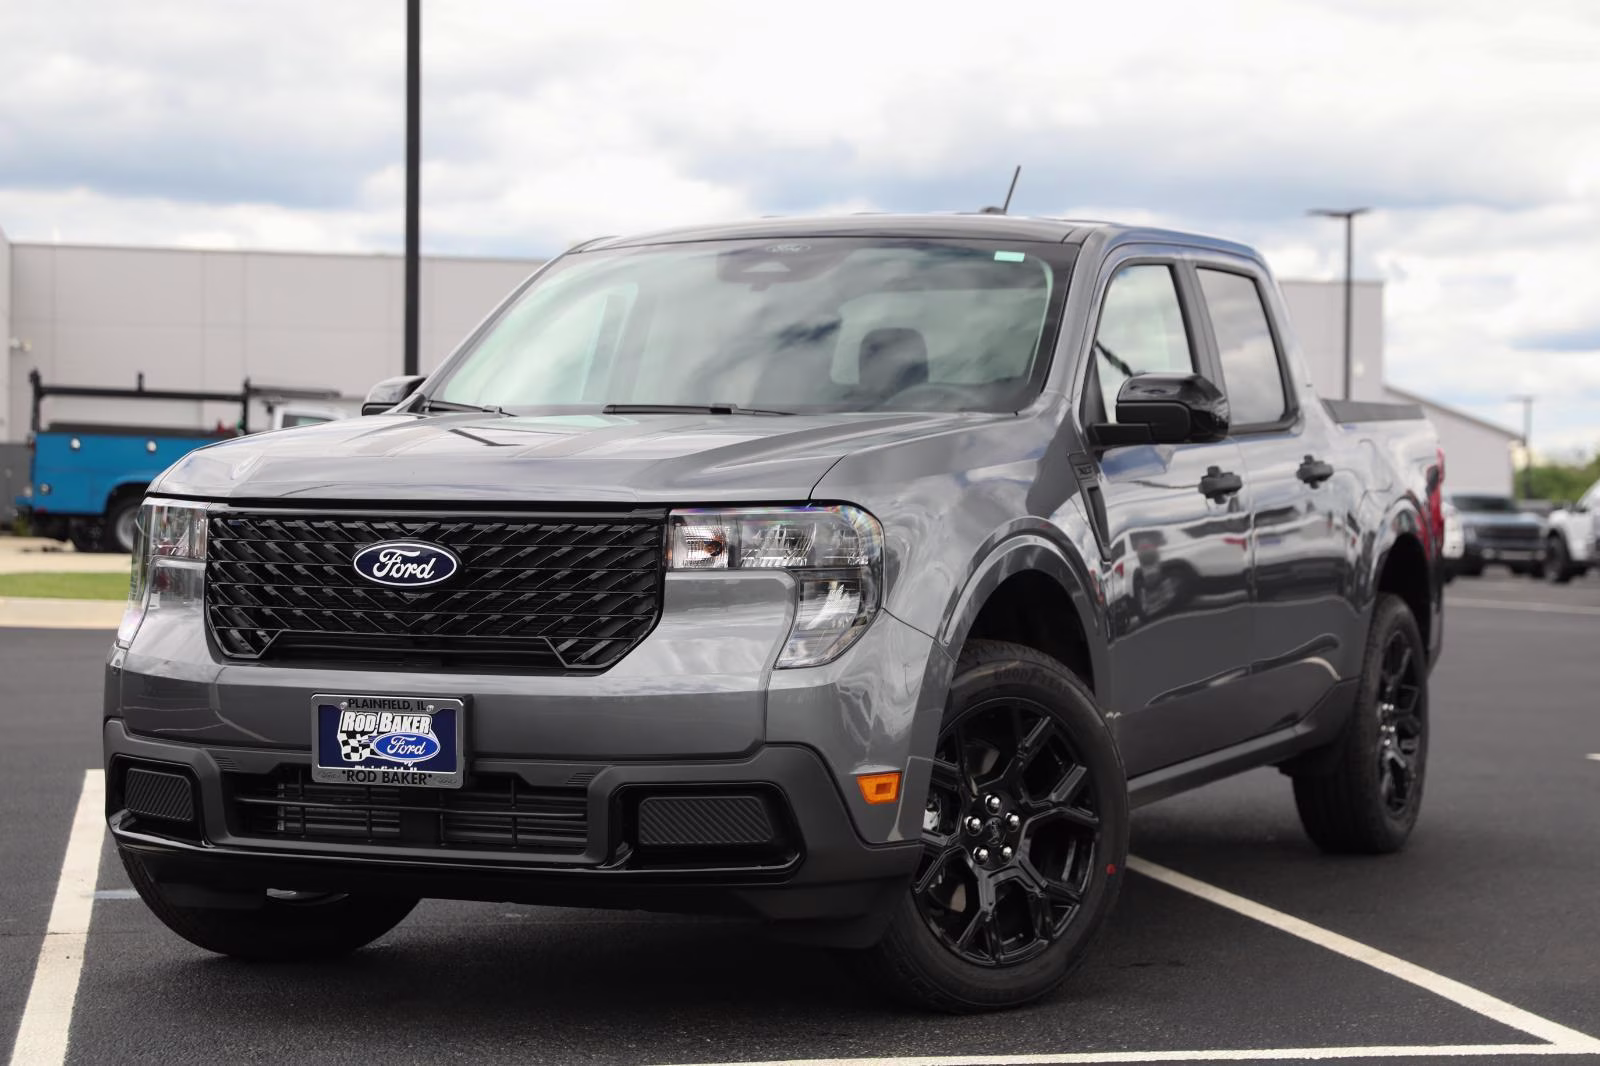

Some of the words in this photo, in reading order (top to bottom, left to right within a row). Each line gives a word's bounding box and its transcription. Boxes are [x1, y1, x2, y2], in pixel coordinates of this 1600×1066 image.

[373, 549, 437, 579] Ford
[348, 699, 413, 712] PLAINFIELD,
[417, 701, 426, 711] IL
[378, 712, 431, 734] BAKER
[387, 735, 426, 755] Ford
